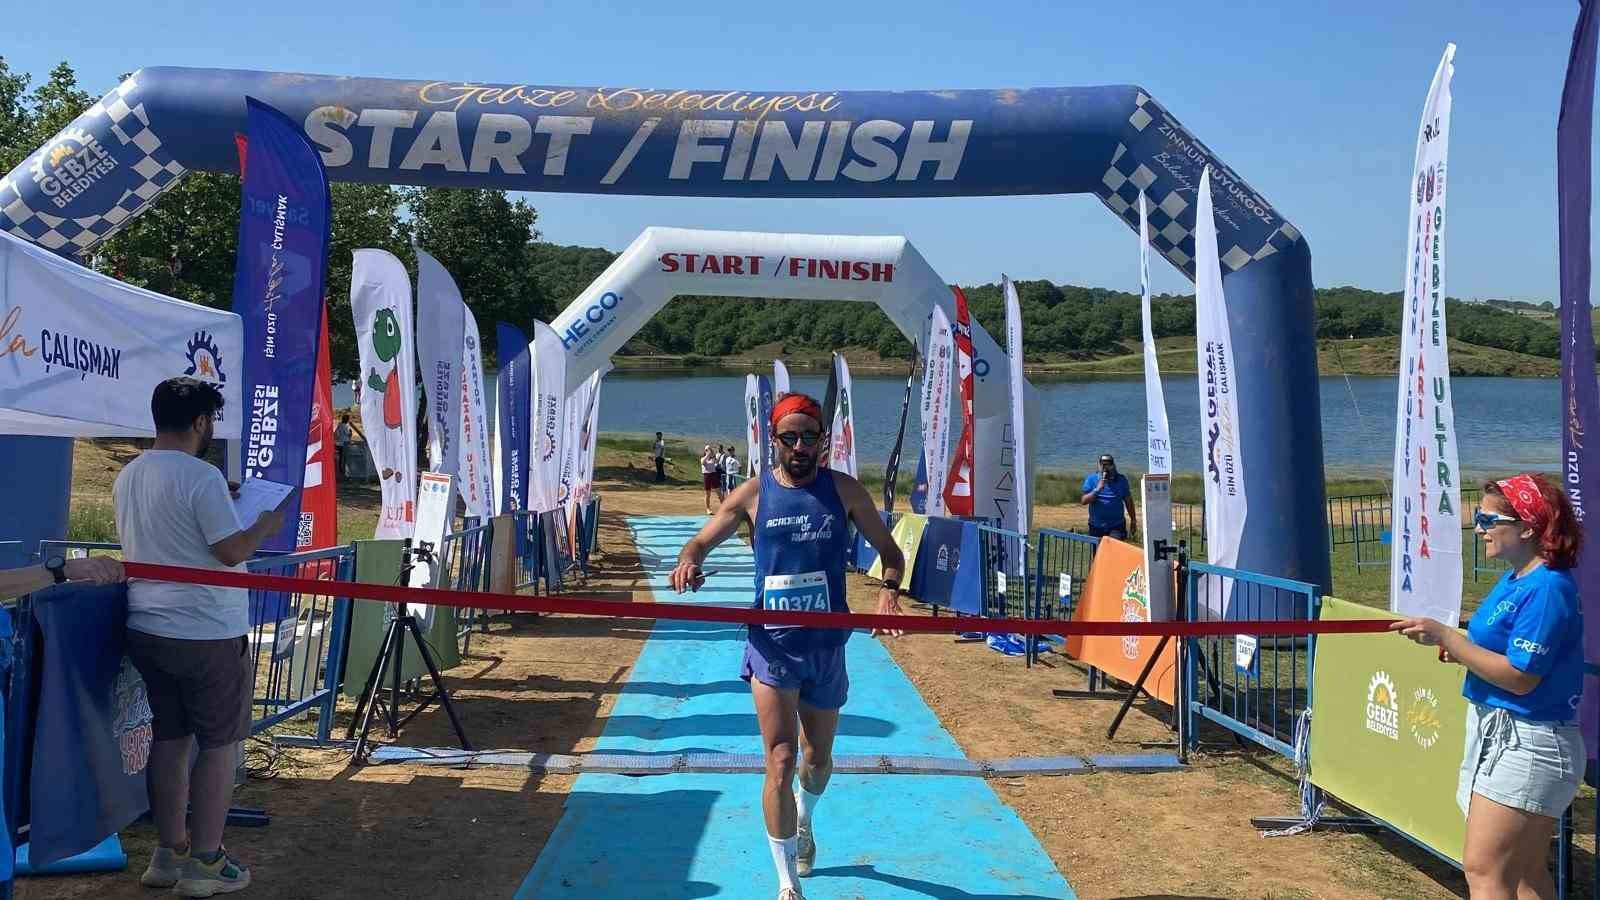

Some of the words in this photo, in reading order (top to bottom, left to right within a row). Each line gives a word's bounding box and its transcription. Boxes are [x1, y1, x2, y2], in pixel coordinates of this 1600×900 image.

[419, 81, 578, 111] Gebze
[587, 87, 842, 133] Belediyesi
[304, 105, 596, 176] START
[668, 119, 974, 182] FINISH
[40, 138, 109, 196] GEBZE
[658, 252, 764, 276] START
[41, 328, 121, 382] ÇALIŞMAK
[563, 318, 590, 350] HE
[1433, 376, 1454, 516] ULTRA
[765, 514, 809, 528] ACADEMY
[1418, 446, 1431, 560] ULTRA
[801, 522, 812, 531] OF
[1401, 496, 1413, 593] ULTRA
[768, 593, 827, 611] 10374
[1513, 637, 1550, 656] CREW
[1366, 702, 1399, 729] GEBZE
